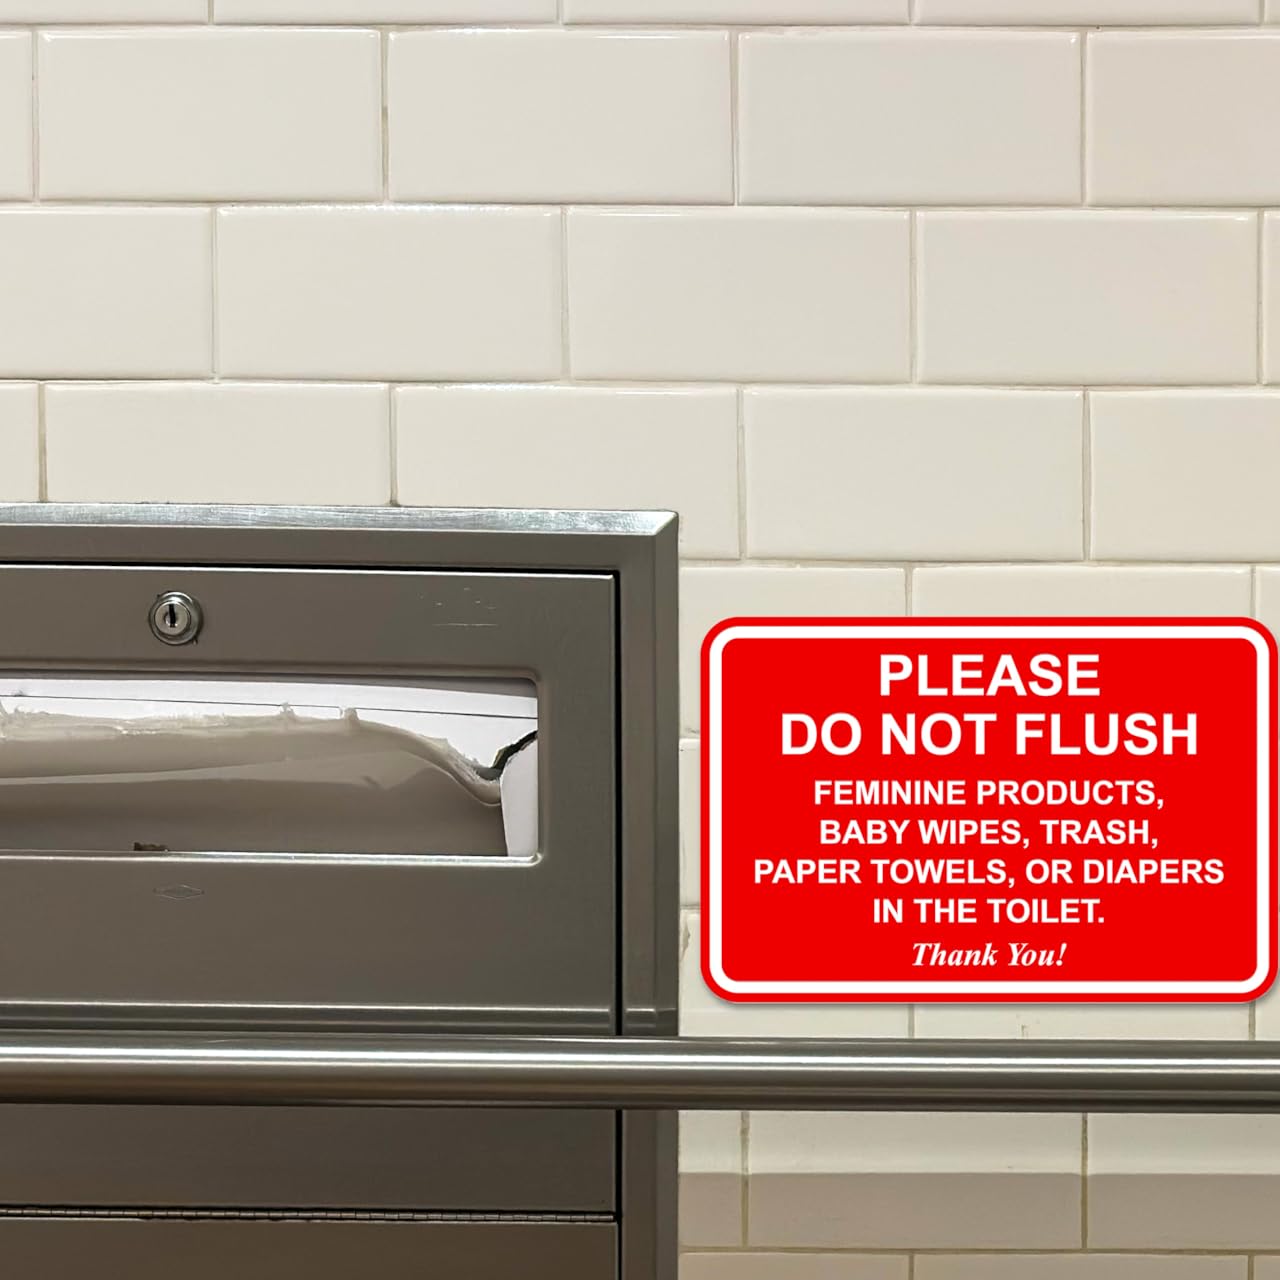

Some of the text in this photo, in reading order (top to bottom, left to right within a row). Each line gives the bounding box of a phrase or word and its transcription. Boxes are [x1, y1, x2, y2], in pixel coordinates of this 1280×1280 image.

[880, 654, 1100, 696] PLEASE
[782, 713, 1197, 755] DO NOT FLUSH
[815, 780, 1163, 809] FEMININE PRODUCTS,
[821, 820, 1157, 849] BABY WIPES, TRASH,
[755, 859, 1224, 888] PAPER TOWELS, OR DIAPERS
[874, 899, 1104, 923] IN THE TOILET.
[912, 943, 1067, 966] Thank You!
